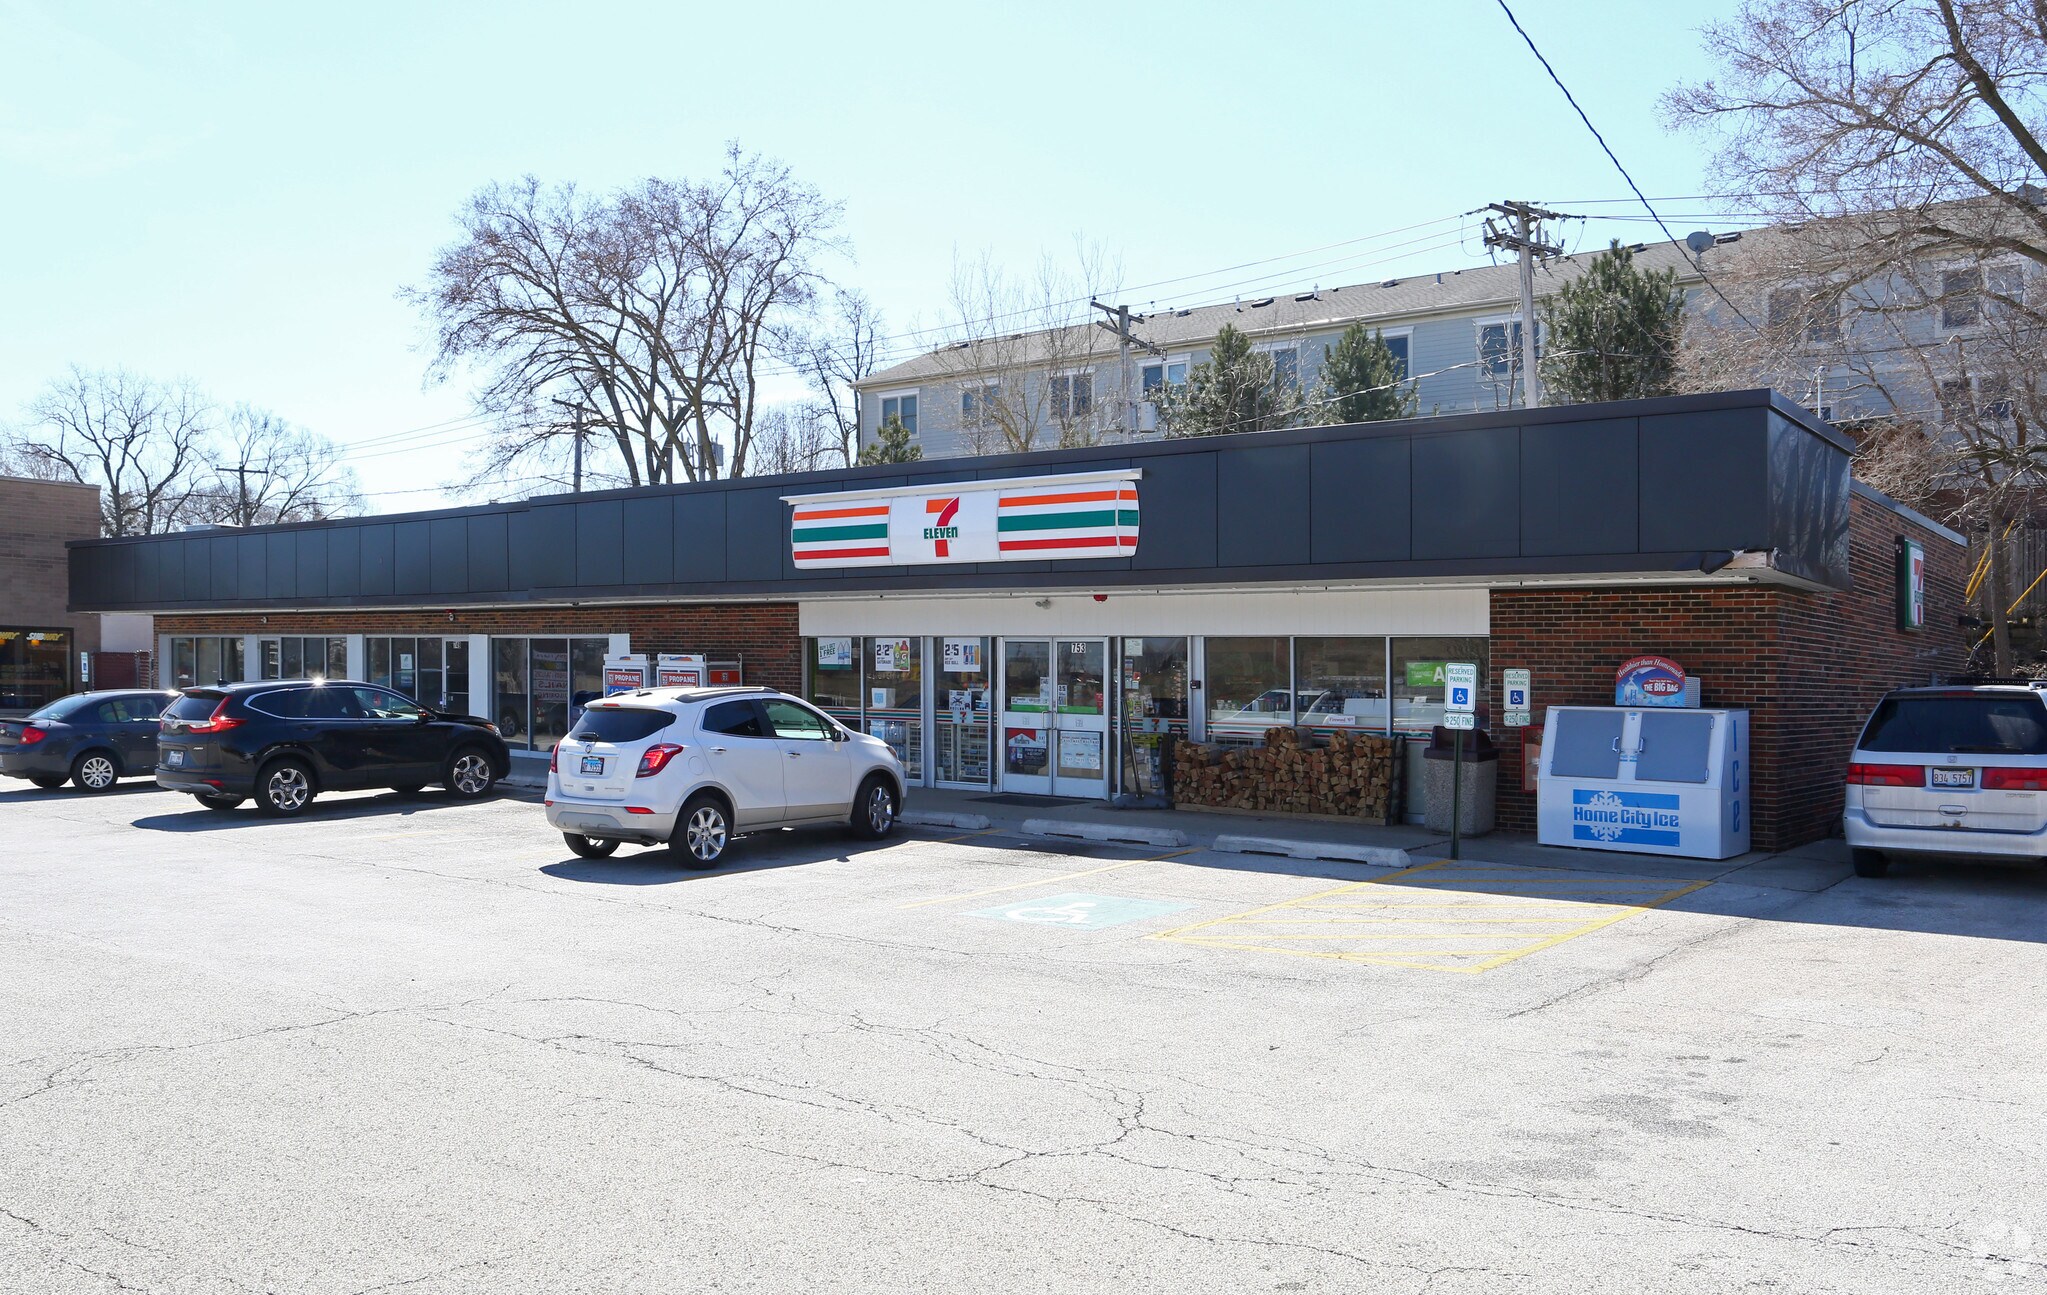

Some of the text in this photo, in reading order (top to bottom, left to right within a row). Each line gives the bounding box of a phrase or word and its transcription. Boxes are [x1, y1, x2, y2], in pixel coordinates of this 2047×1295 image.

[926, 496, 959, 557] 7
[26, 632, 64, 641] SUBWAY
[823, 647, 836, 657] FREE
[1072, 642, 1086, 653] 753
[1448, 667, 1474, 676] RESERVED
[1617, 658, 1684, 679] Healthier than Homemade
[614, 674, 640, 683] PROPANE
[668, 674, 696, 684] PROPANE
[1449, 675, 1473, 684] PARKING
[1643, 682, 1679, 693] THE BIG BAG
[1445, 715, 1473, 727] $250 FINE
[1519, 715, 1529, 724] FINE
[1934, 773, 1973, 785] 834 5757
[1573, 806, 1680, 828] Home City Ice
